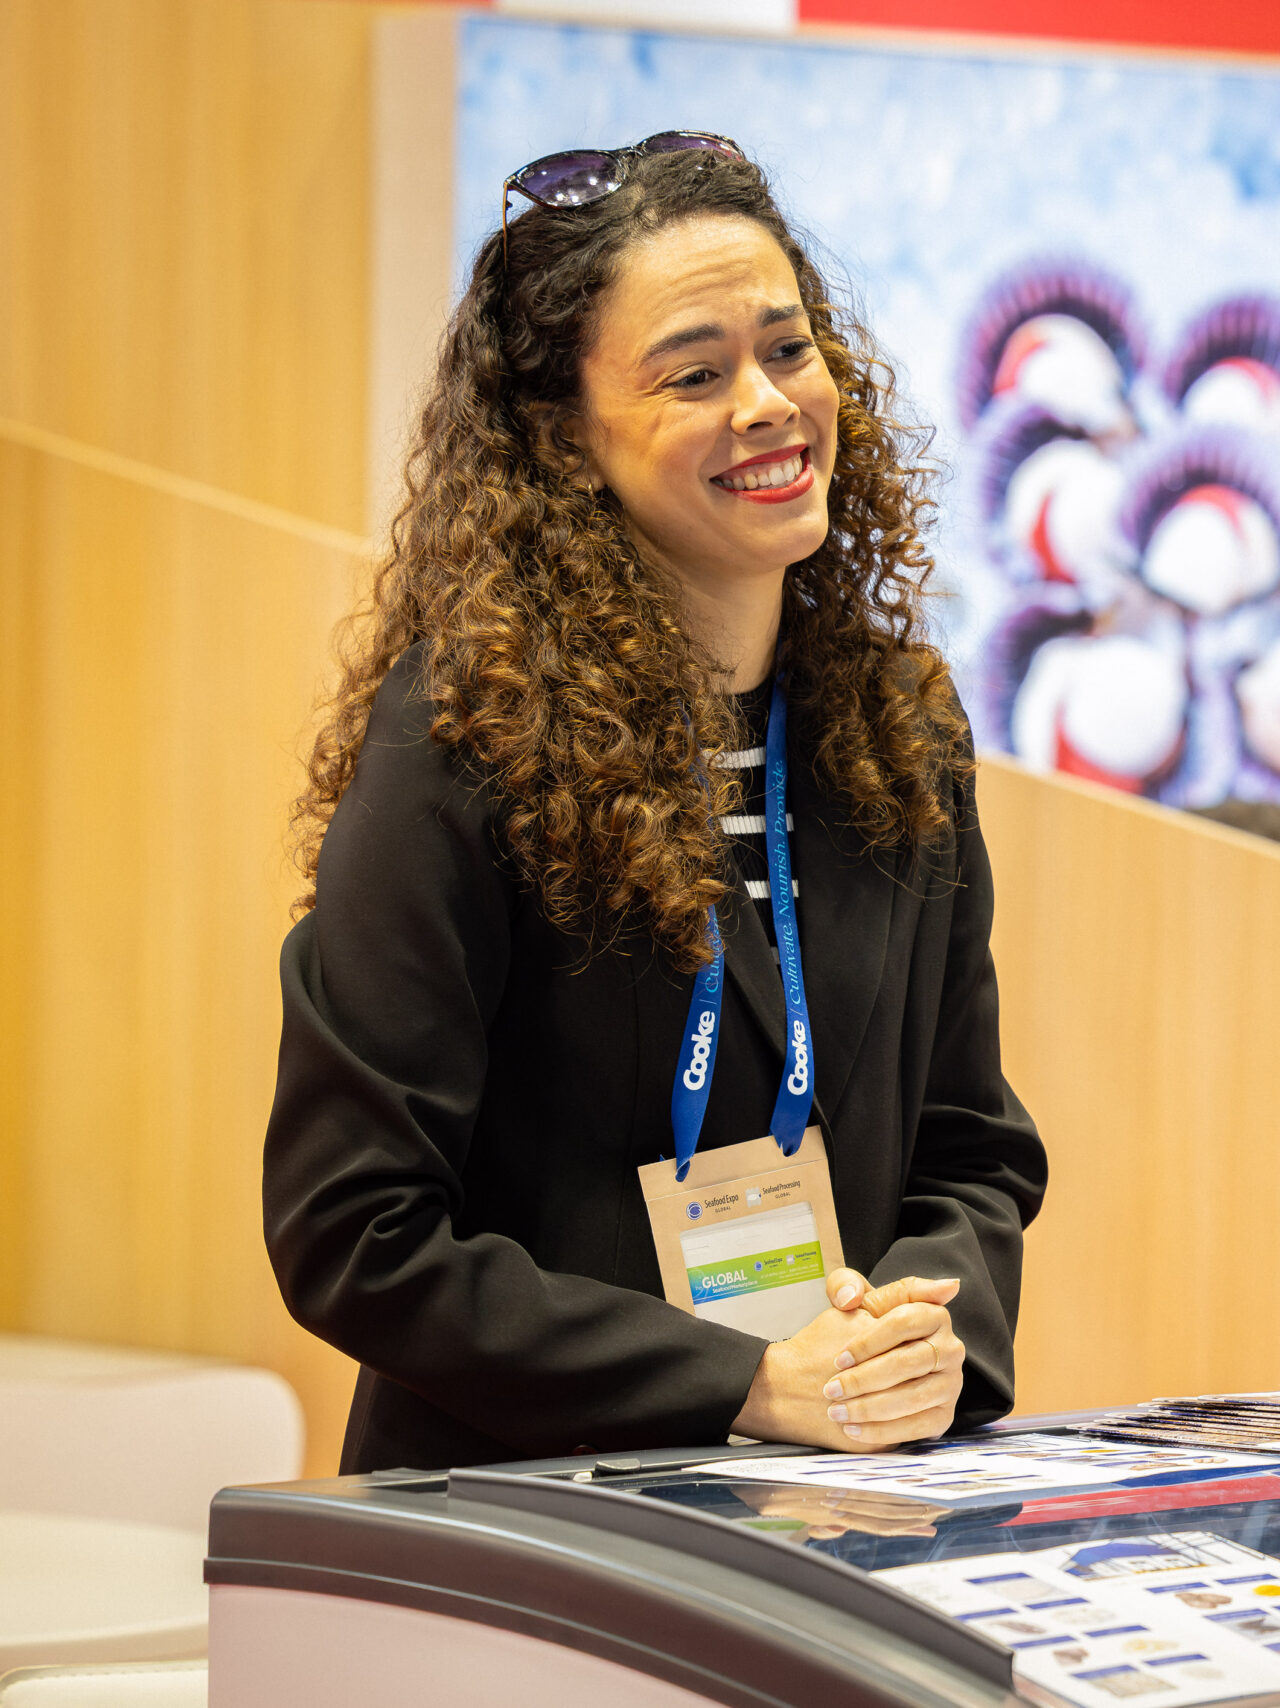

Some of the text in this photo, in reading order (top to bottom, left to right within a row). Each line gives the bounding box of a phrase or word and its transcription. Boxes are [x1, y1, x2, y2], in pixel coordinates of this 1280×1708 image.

[772, 760, 808, 1096] Cooke Cultivate. Nourish. Provide.
[683, 1011, 715, 1090] Cooke
[762, 1180, 801, 1194] Seafood Processing
[704, 1193, 739, 1208] Seafood Expo
[702, 1269, 748, 1289] GLOBAL
